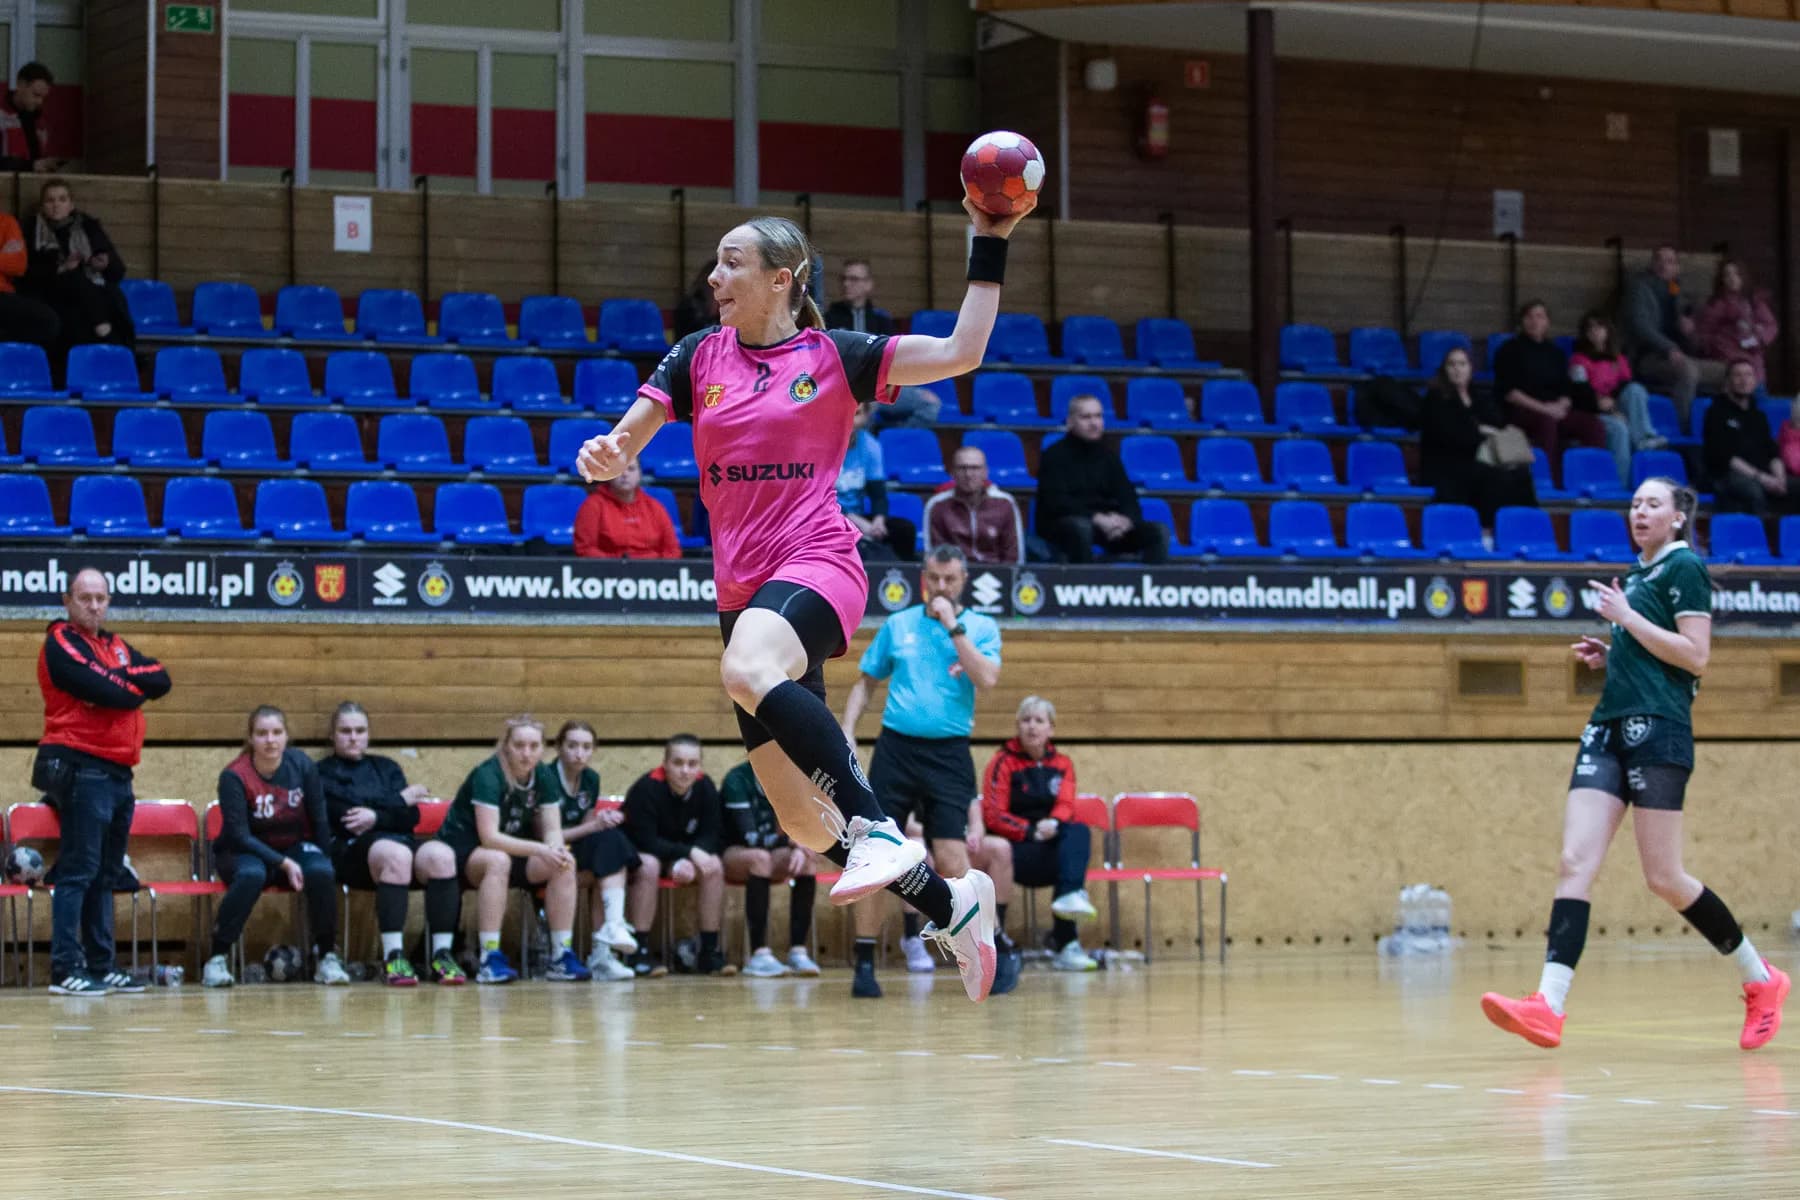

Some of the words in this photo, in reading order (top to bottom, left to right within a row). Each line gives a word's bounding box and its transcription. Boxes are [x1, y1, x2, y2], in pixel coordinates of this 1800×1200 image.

[753, 362, 771, 393] 2
[726, 463, 815, 482] SUZUKI
[0, 558, 254, 607] nahndball.pl
[464, 566, 718, 601] www.koronaha
[1054, 575, 1416, 619] www.koronahandball.pl
